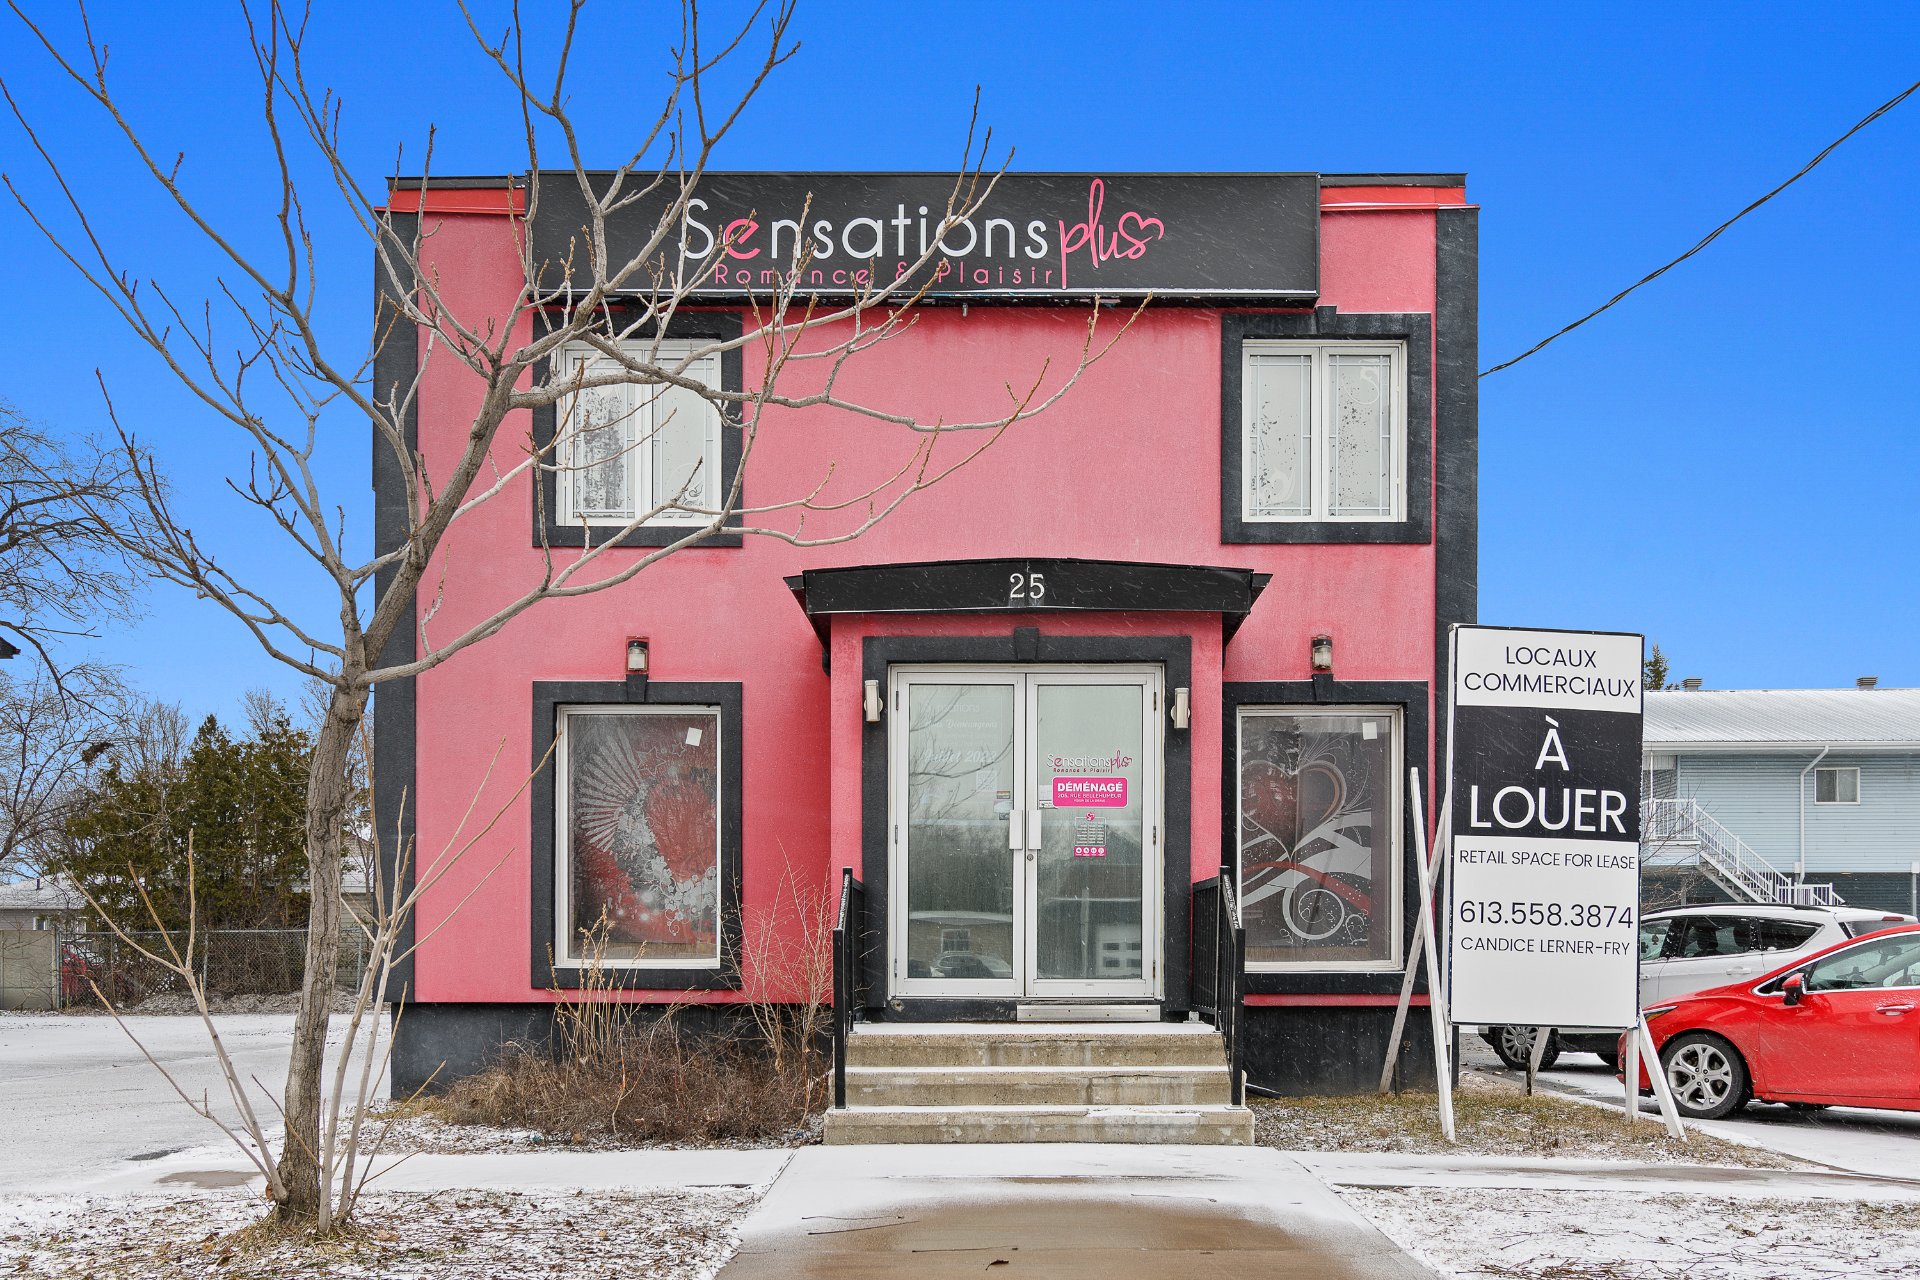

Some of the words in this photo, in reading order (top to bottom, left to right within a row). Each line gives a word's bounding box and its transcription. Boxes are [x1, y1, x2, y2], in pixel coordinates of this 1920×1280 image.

[678, 198, 1048, 260] Sensations
[1058, 178, 1164, 290] plus
[715, 263, 870, 284] Romance
[938, 261, 1052, 284] Plaisir
[1009, 573, 1045, 599] 25
[1506, 646, 1597, 669] LOCAUX
[1464, 672, 1635, 698] COMMERCIAUX
[1535, 714, 1570, 771] À
[1047, 753, 1110, 768] Sensations
[1057, 781, 1123, 792] DÉMÉNAGÉ
[1470, 785, 1627, 834] LOUER
[1459, 850, 1507, 865] RETAIL
[1511, 851, 1560, 867] SPACE
[1564, 853, 1593, 868] FOR
[1597, 855, 1636, 870] LEASE
[1460, 900, 1634, 929] 613.558.3874
[1460, 936, 1535, 953] CANDICE
[1540, 939, 1631, 956] LERNER-FRY
